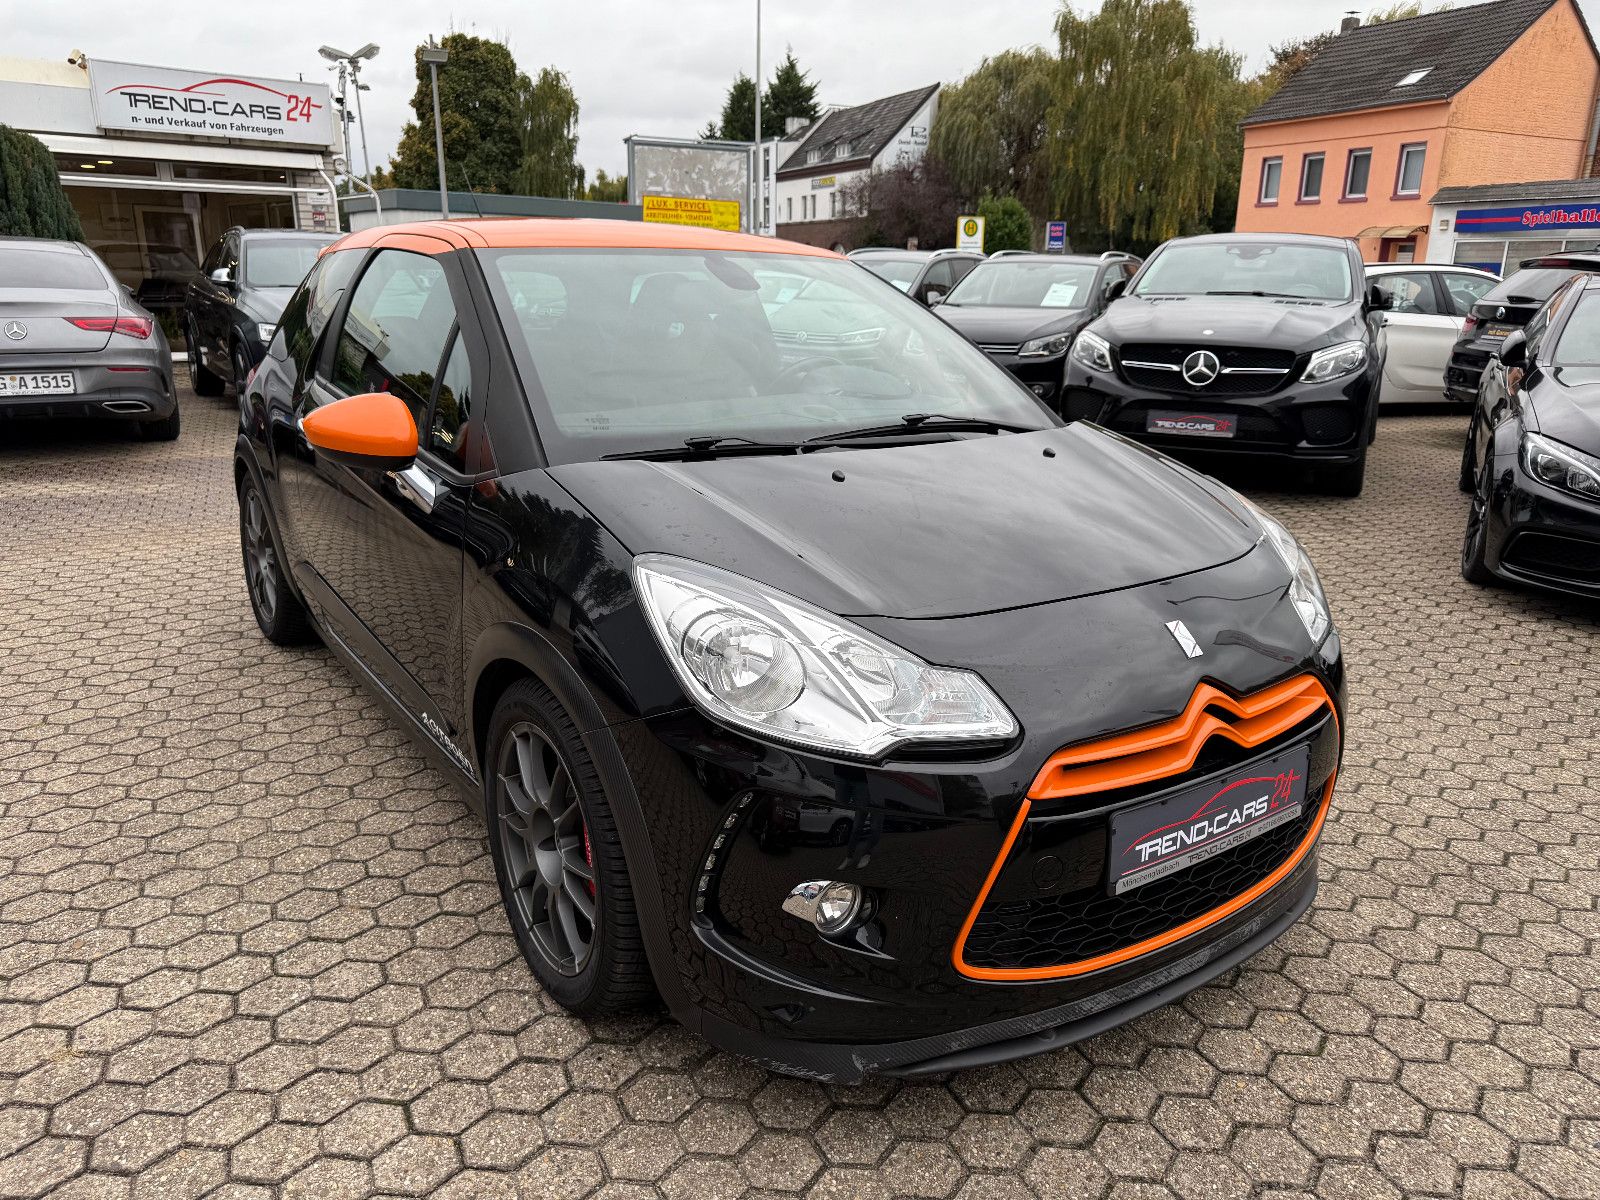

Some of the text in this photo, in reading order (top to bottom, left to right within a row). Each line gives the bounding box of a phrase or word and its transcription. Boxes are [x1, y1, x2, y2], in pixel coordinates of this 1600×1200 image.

[120, 91, 312, 123] TREND-CARS 24
[144, 116, 165, 127] und
[167, 117, 206, 130] Verkauf
[209, 122, 227, 131] von
[230, 122, 284, 136] Fahrzeugen
[674, 201, 706, 211] SERVICE
[19, 376, 28, 389] A
[31, 375, 71, 389] 1515
[1155, 420, 1215, 431] TREND-CARS
[1135, 795, 1268, 863] TREND-CARS
[1270, 768, 1295, 809] 24
